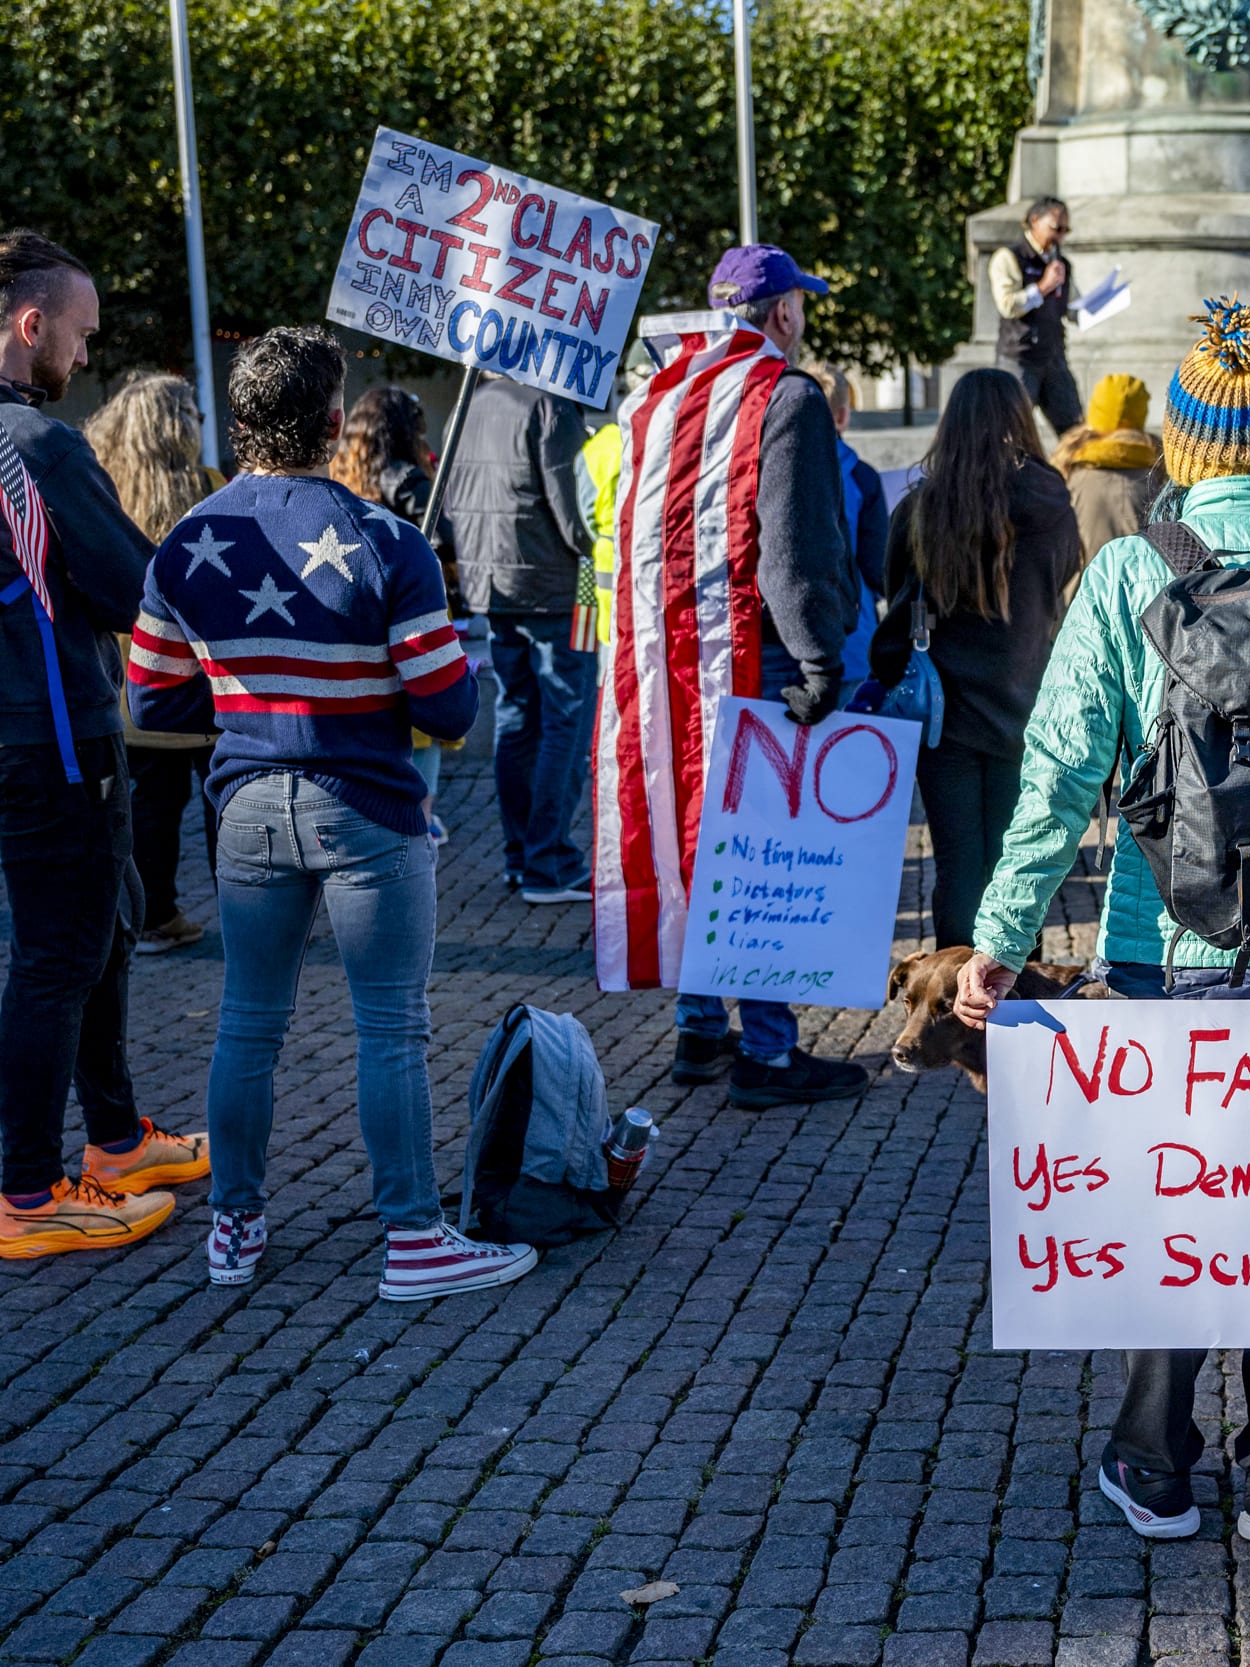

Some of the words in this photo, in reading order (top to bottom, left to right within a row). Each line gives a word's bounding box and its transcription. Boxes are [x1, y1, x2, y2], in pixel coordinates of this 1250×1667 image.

[387, 141, 452, 193] I'M
[395, 183, 424, 214] A
[511, 193, 649, 279] CLASS
[351, 261, 405, 301] IN
[406, 283, 456, 320] MY
[358, 208, 611, 335] CITIZEN
[366, 301, 445, 349] OWN
[447, 300, 618, 398] COUNTRY
[722, 708, 897, 823] NO
[732, 834, 756, 862] No
[710, 957, 738, 986] in
[1046, 1025, 1154, 1106] NO
[1013, 1142, 1110, 1212] YES
[1018, 1233, 1127, 1293] YES
